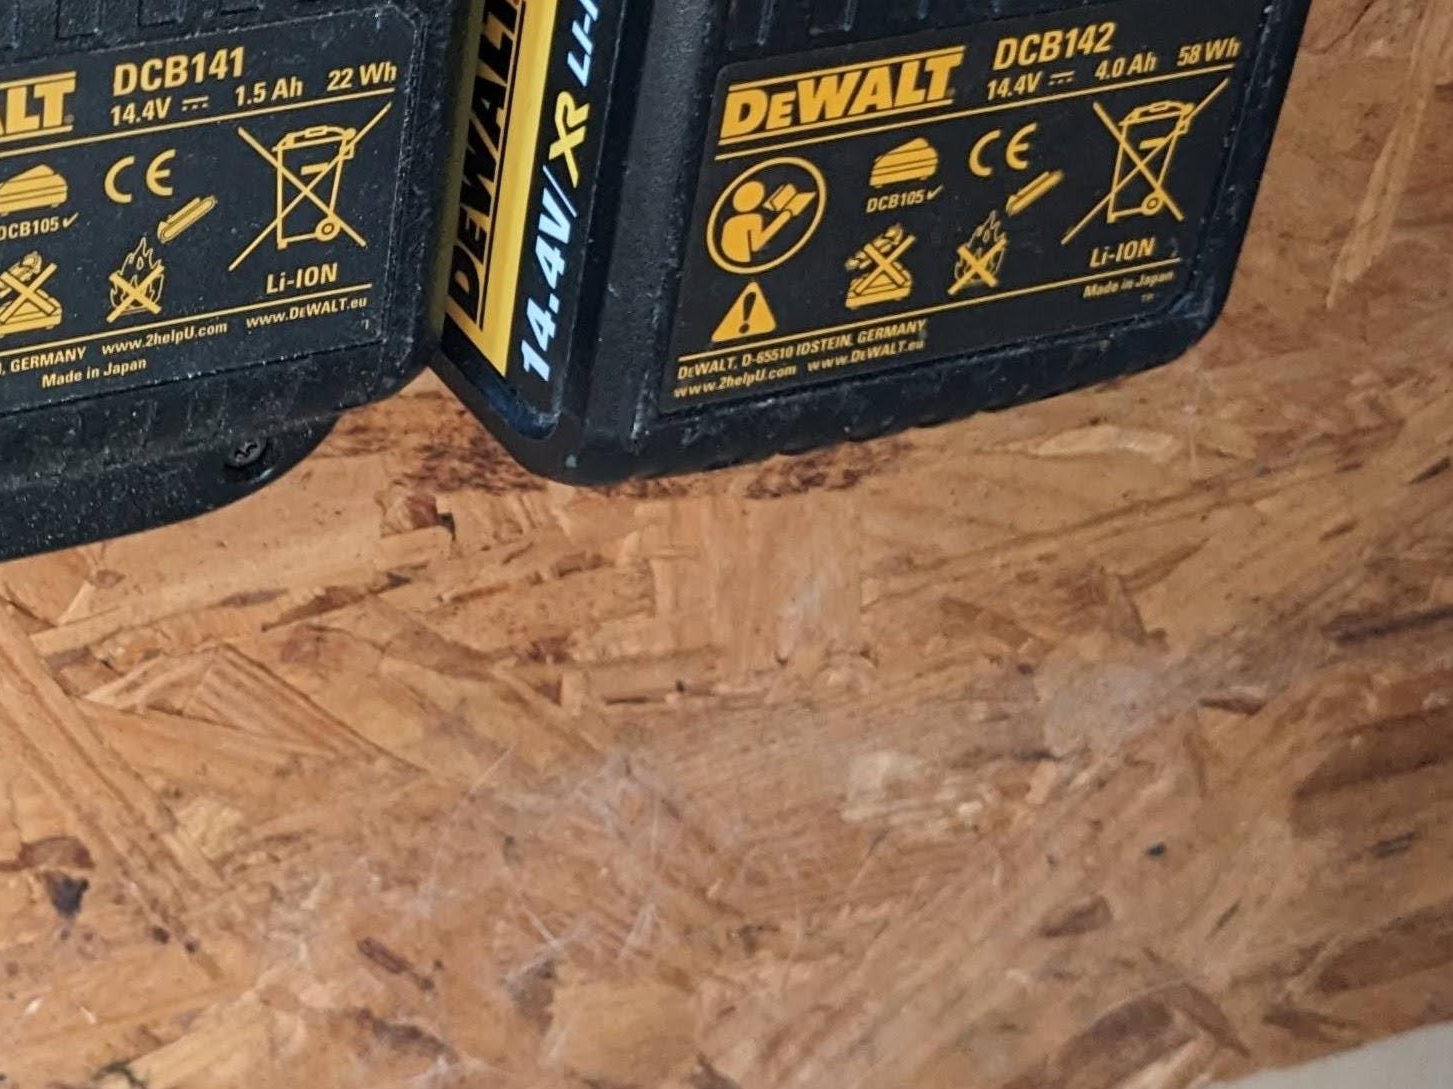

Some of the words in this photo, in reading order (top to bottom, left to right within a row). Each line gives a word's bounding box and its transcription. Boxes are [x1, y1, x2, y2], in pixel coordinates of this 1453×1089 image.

[987, 71, 1042, 100] 14.4V
[1095, 58, 1123, 80] 4.0
[1127, 52, 1158, 75] Ah
[1177, 44, 1199, 66] 58
[1205, 36, 1242, 61] Wh
[993, 21, 1117, 70] DCB142
[110, 96, 172, 126] 14.4V
[235, 82, 266, 107] 1.5
[271, 76, 303, 101] Ah
[327, 67, 353, 91] 22
[359, 61, 397, 86] Wh
[113, 46, 245, 97] DCB141
[969, 122, 1037, 177] CE
[104, 148, 176, 204] CE
[866, 189, 925, 213] DCB105
[1090, 236, 1156, 268] Li-ION
[266, 262, 338, 295] Li-ION
[10, 346, 87, 373] GERMANY
[102, 321, 228, 356] www.2helpU.com
[857, 319, 927, 343] GERMANY
[41, 371, 82, 389] Made
[86, 366, 100, 379] in
[103, 358, 147, 378] Japan
